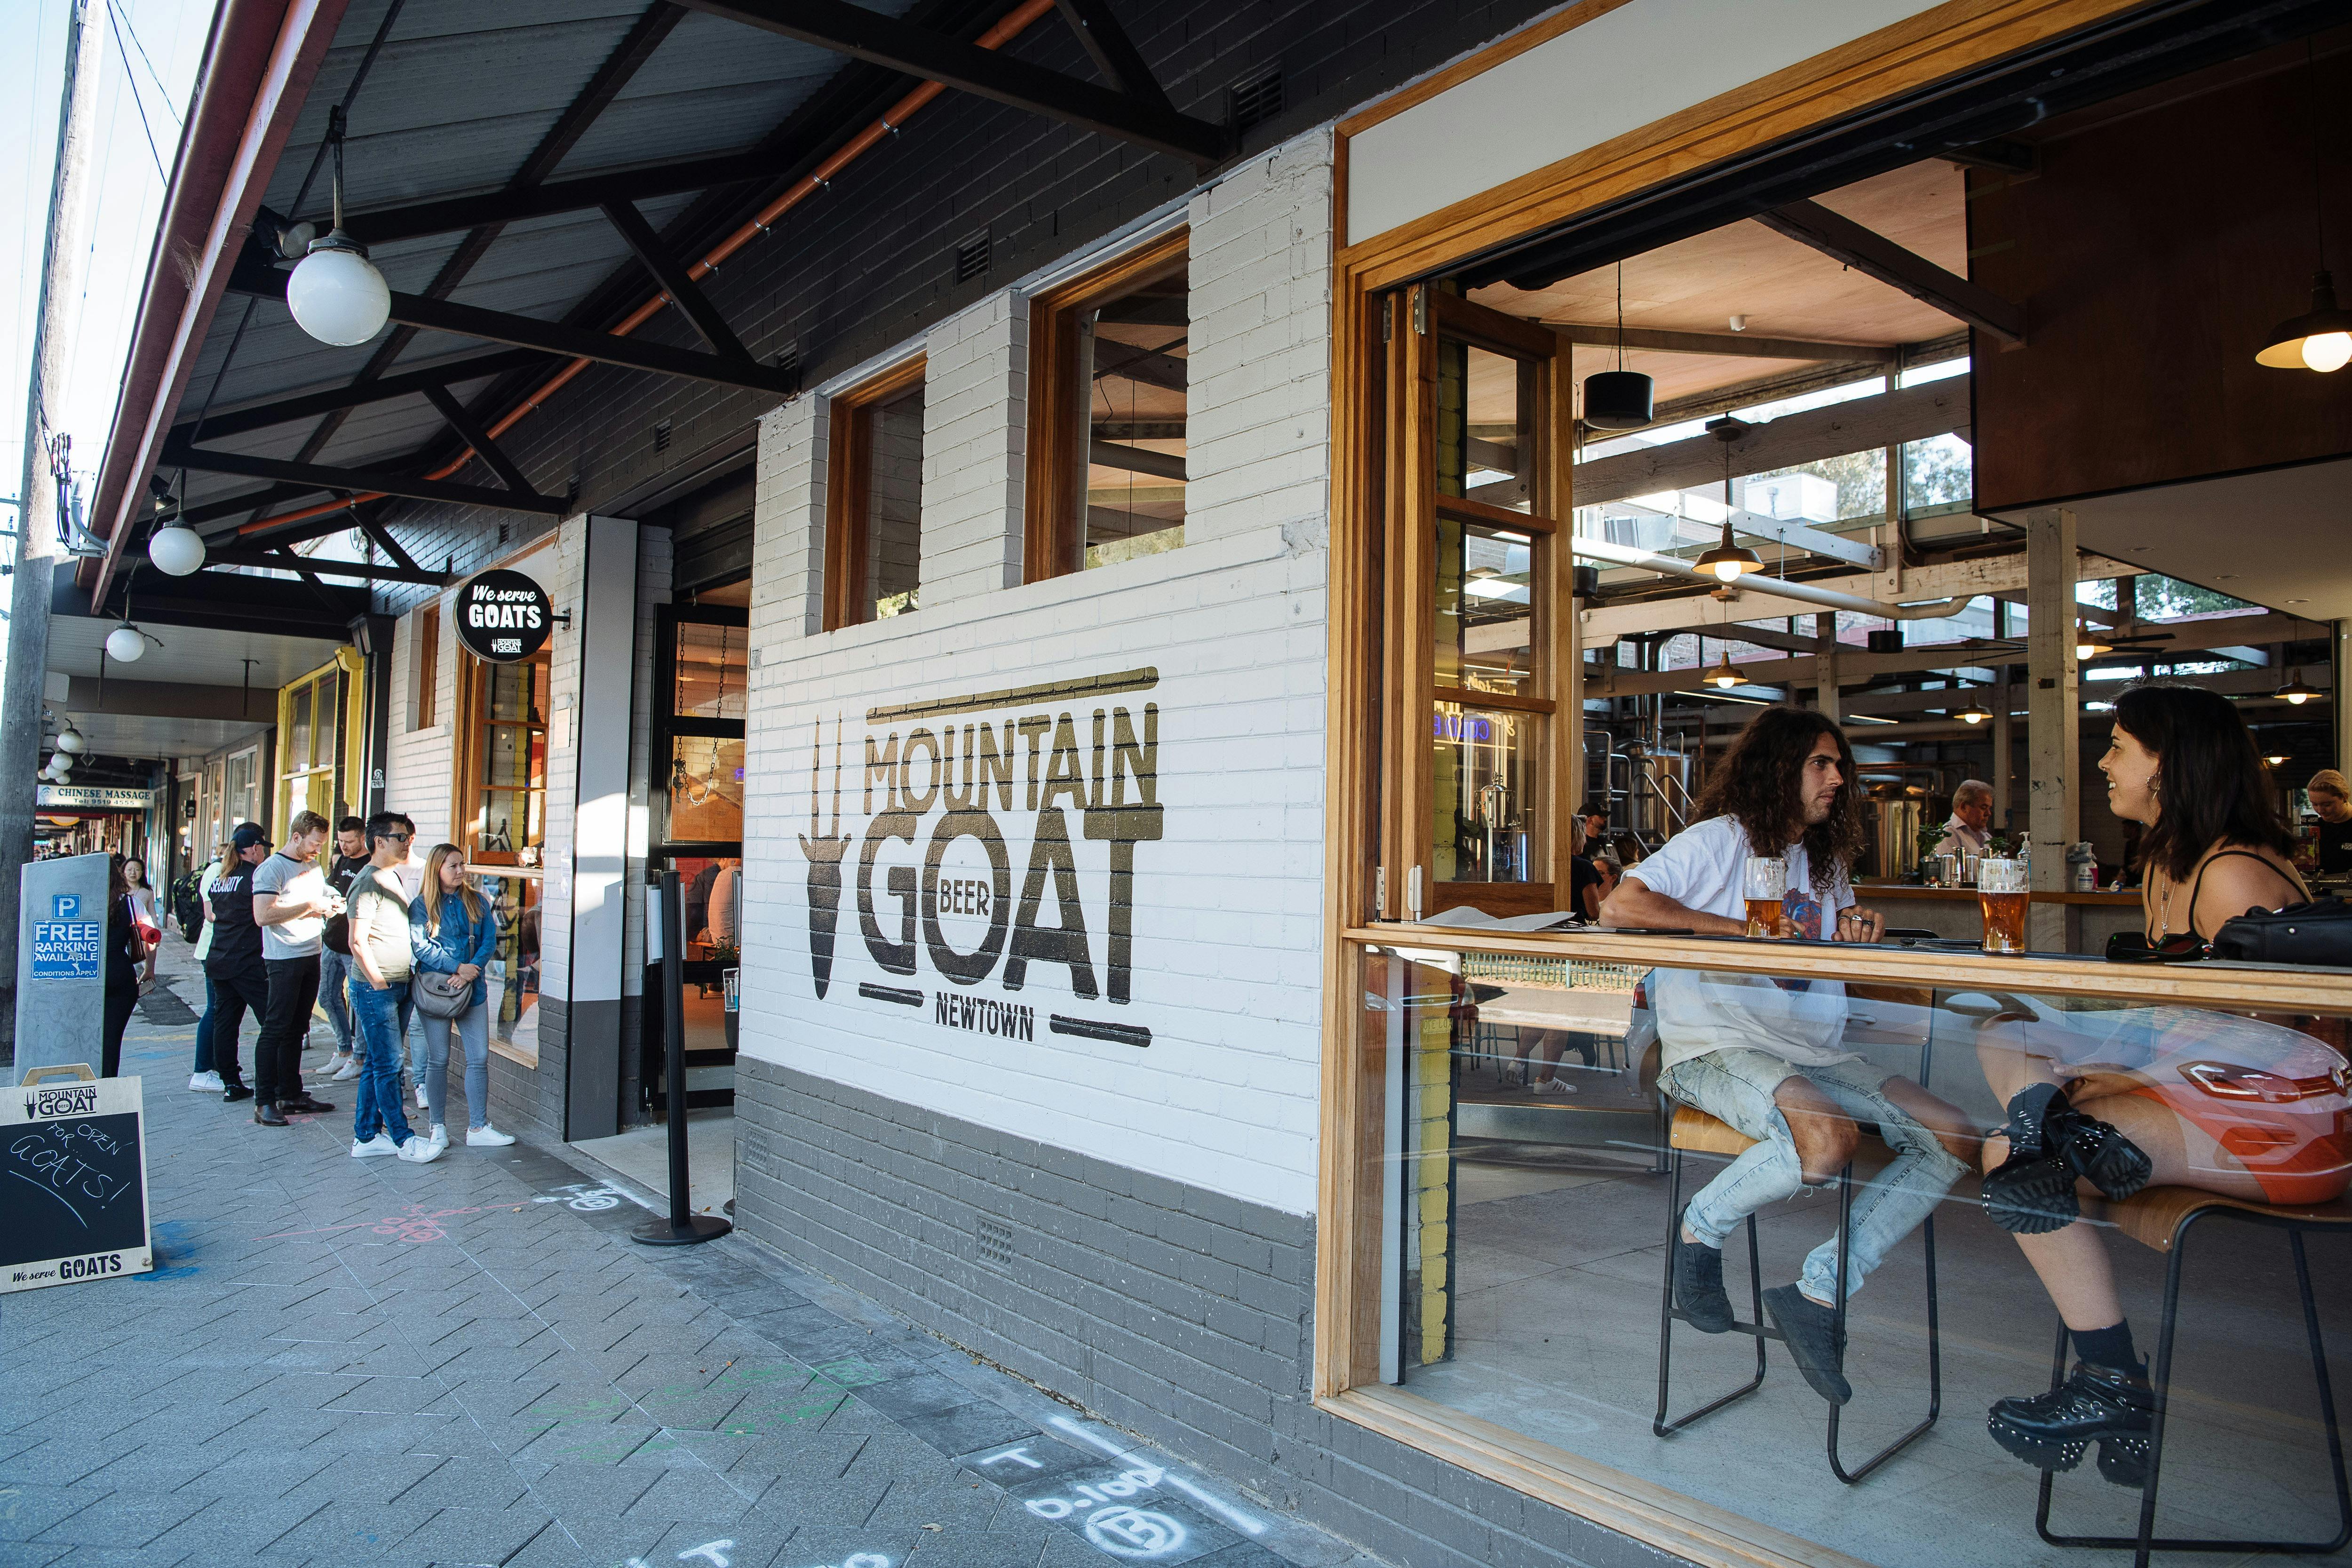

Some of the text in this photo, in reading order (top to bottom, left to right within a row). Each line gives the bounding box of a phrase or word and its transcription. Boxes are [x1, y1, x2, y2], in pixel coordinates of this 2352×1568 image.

[472, 585, 537, 602] We serve
[469, 604, 541, 628] GOATS
[865, 702, 1159, 815] MOUNTAIN
[58, 788, 150, 799] CHINESE MASSAGE
[211, 876, 244, 892] SECURITY
[857, 806, 1163, 1005] GOAT
[940, 879, 989, 916] BEER
[59, 898, 75, 916] P
[35, 924, 98, 940] FREE
[35, 942, 98, 952] PARKING
[34, 953, 97, 962] AVAILABLE
[936, 992, 1034, 1042] NEWTOWN
[39, 1088, 96, 1101] MOUNTAIN
[39, 1096, 97, 1115] GOAT
[78, 1124, 135, 1155] OPEN
[13, 1254, 122, 1282] We serve GOATS
